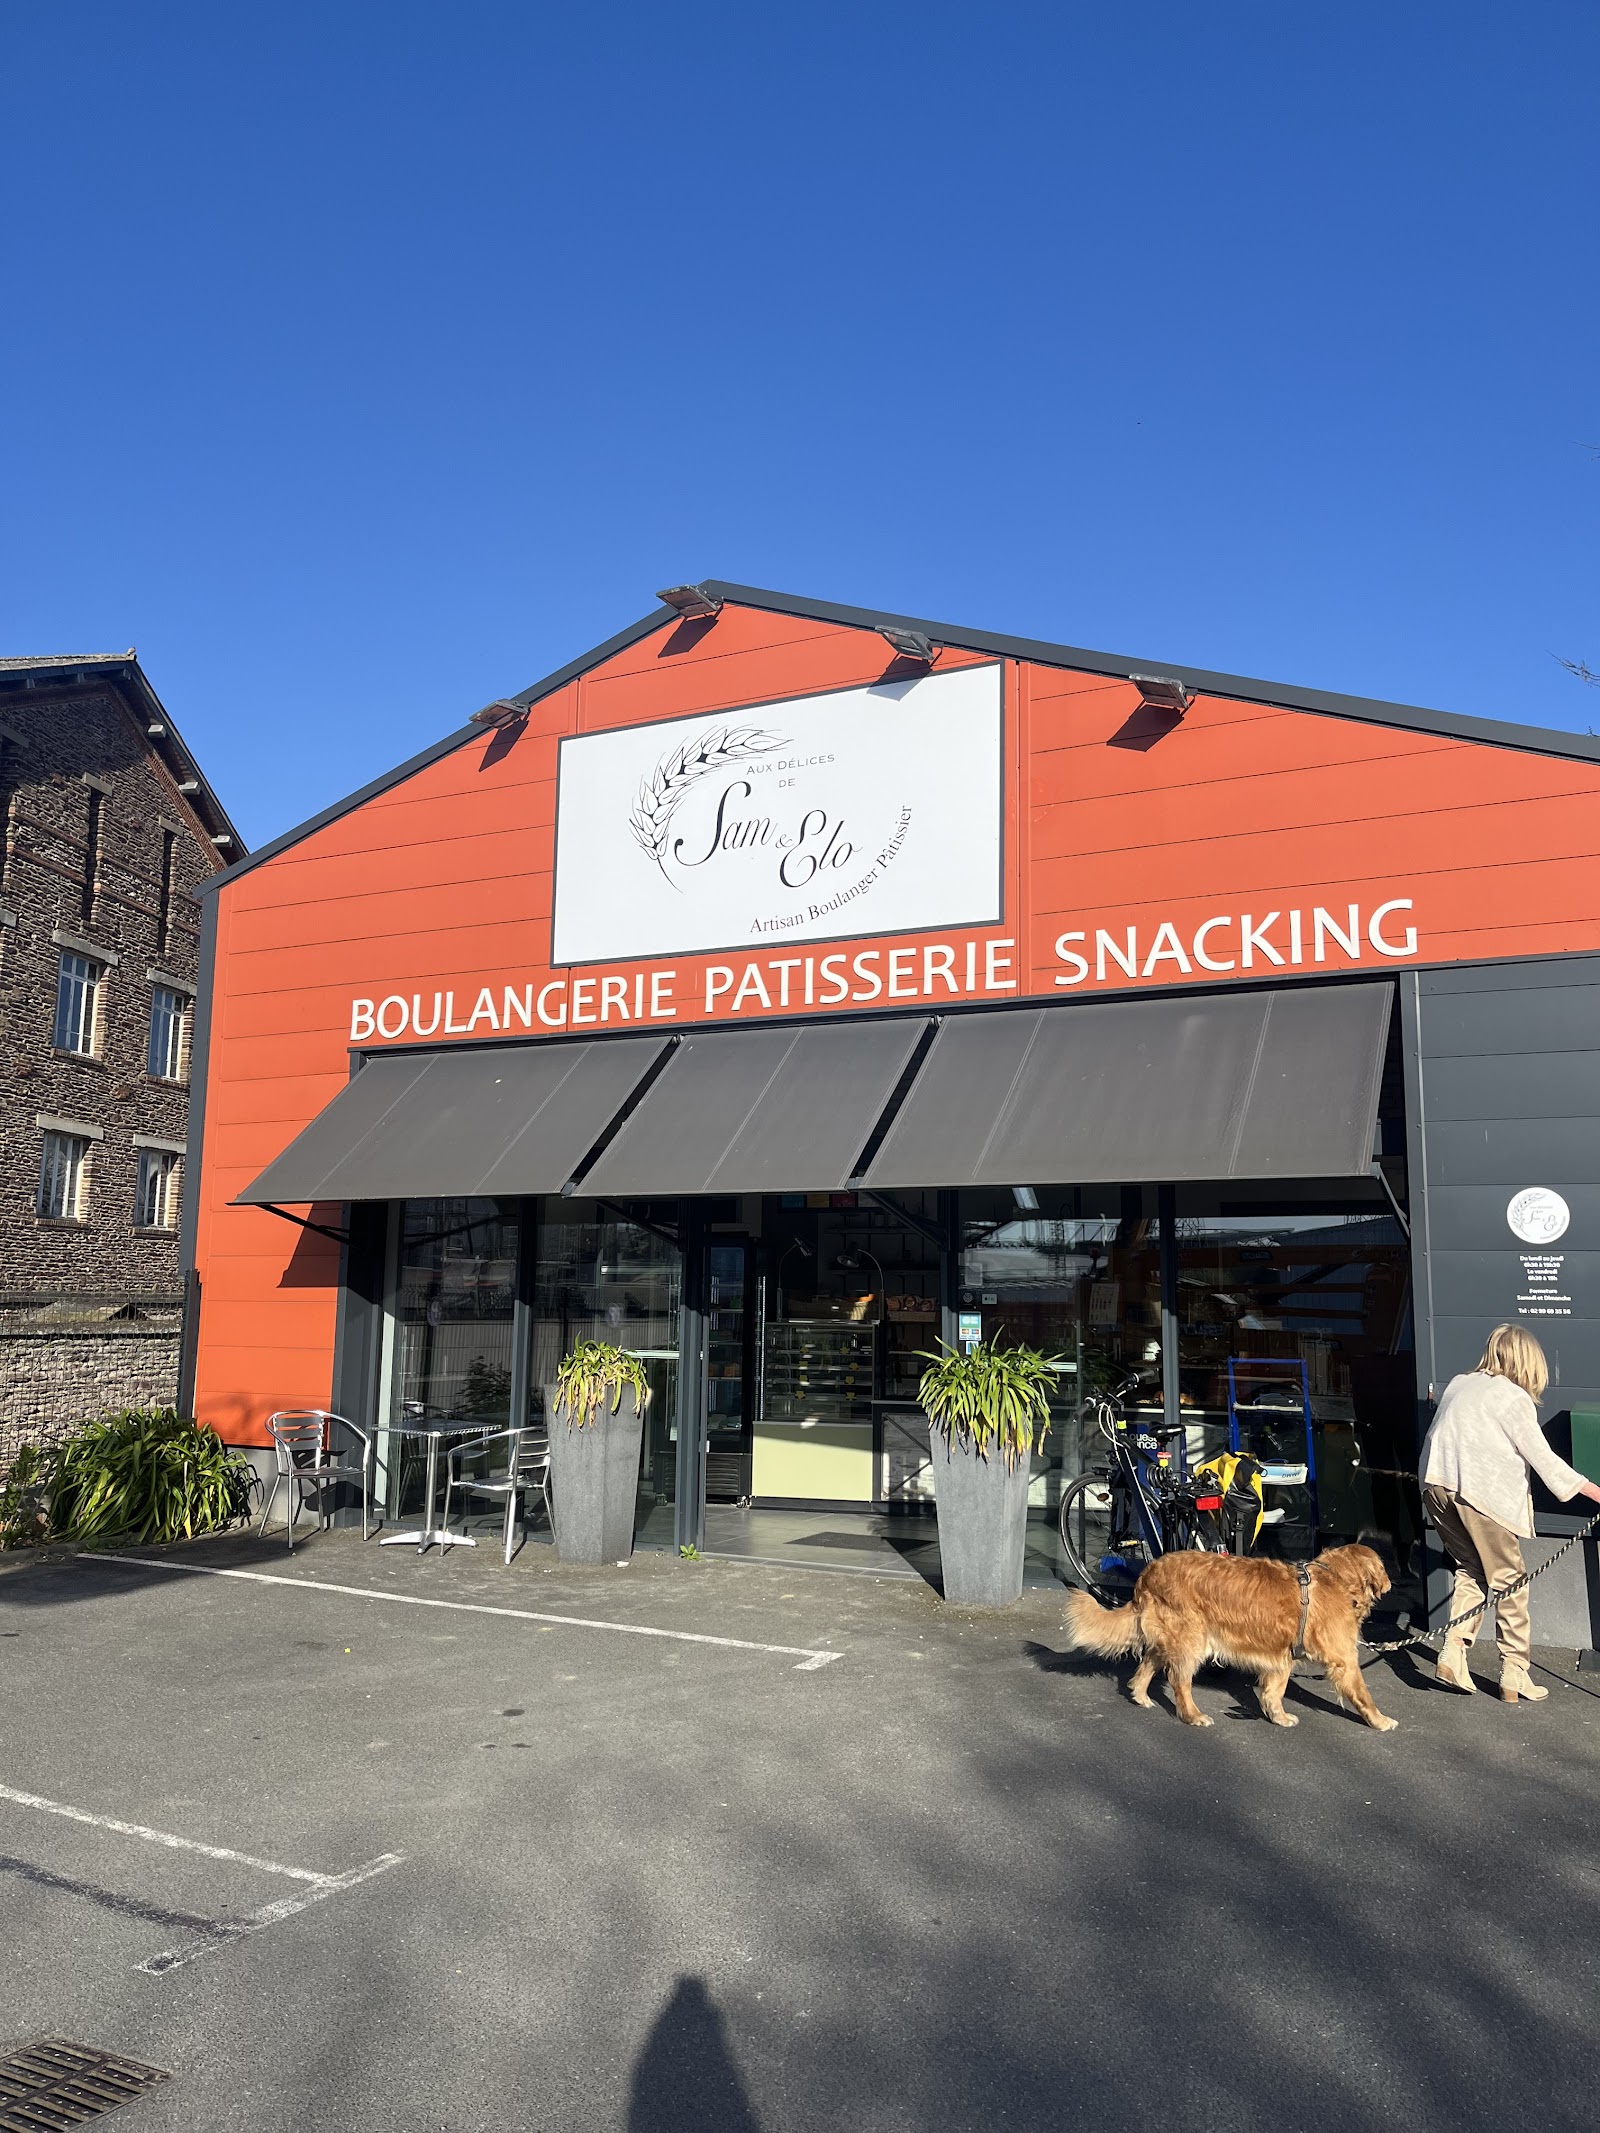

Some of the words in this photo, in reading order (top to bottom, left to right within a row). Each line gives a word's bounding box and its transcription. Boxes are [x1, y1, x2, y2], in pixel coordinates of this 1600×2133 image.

[674, 781, 776, 866] Sam
[775, 834, 795, 849] &
[779, 809, 862, 888] Elo
[749, 913, 804, 934] Artisan
[807, 868, 878, 921] Boulanger
[875, 804, 914, 871] Pâtissier
[349, 970, 677, 1042] BOULANGERIE
[704, 938, 1018, 1013] PATISSERIE
[1054, 898, 1419, 986] SNACKING
